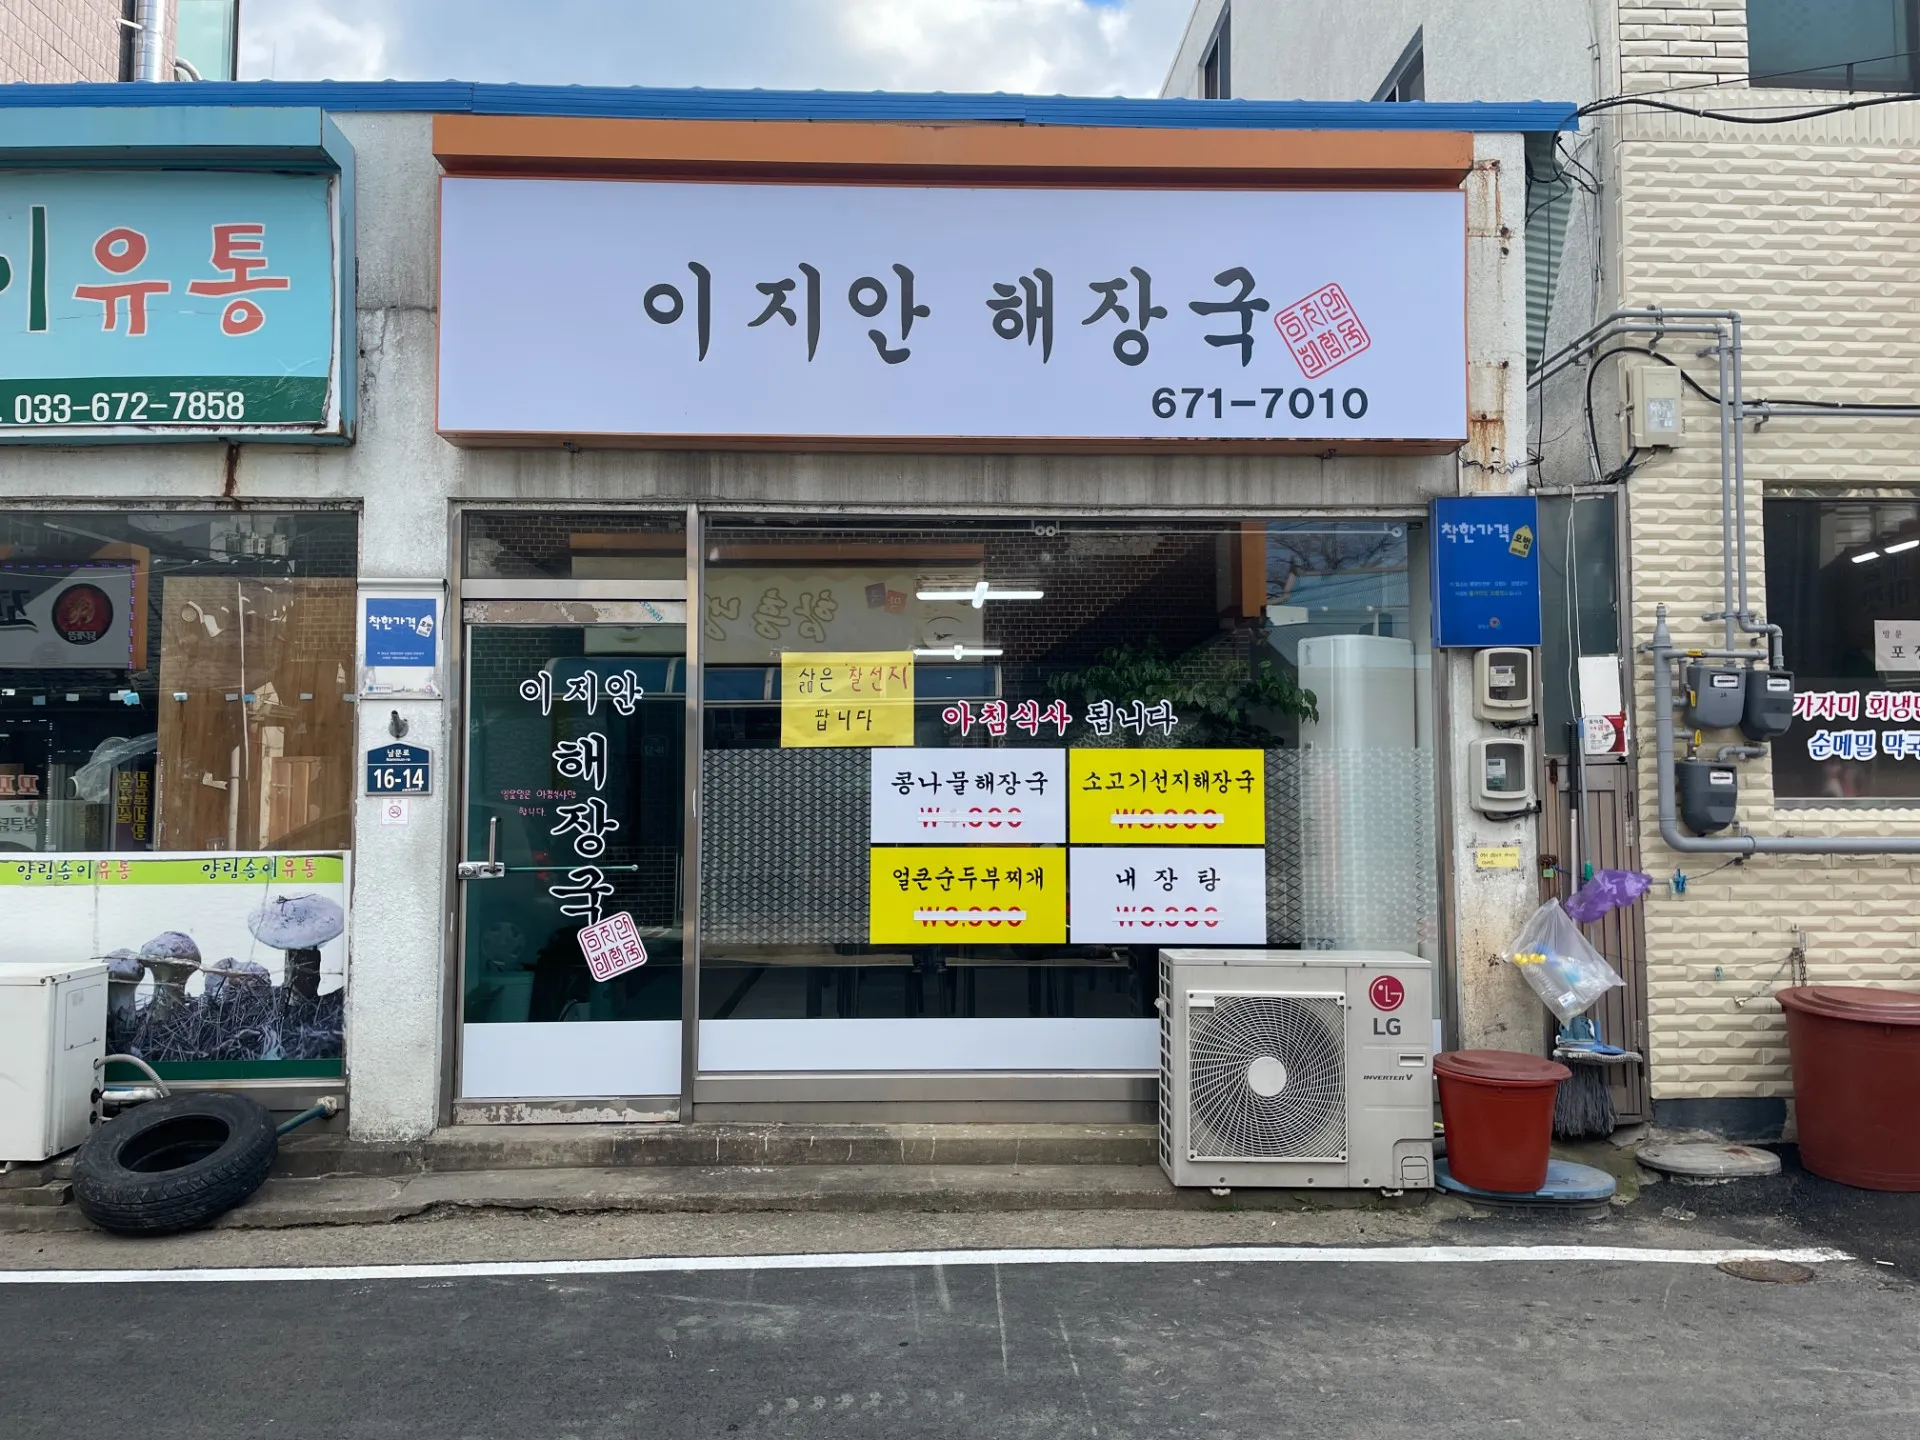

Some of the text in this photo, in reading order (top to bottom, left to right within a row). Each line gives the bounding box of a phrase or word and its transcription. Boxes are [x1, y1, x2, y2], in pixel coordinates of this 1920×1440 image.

[643, 261, 1270, 368] 이지안 해장국
[14, 391, 246, 424] 033-672-7858
[1151, 386, 1369, 420] 671-7010
[1441, 521, 1510, 544] 착한가격
[1513, 533, 1532, 550] 모범
[368, 614, 416, 631] 착한가격
[519, 669, 643, 716] 이지안
[799, 667, 833, 693] 삶은
[942, 699, 1179, 736] 아침식사 됩니다
[1793, 691, 1860, 721] 가자미
[815, 708, 872, 731] 팝니다
[1808, 730, 1877, 761] 순메밀
[373, 767, 425, 789] 16-14
[891, 770, 1049, 796] 콩나물해장국
[1081, 769, 1255, 795] 소고기선지해장국
[549, 731, 620, 928] 해장국
[892, 866, 1045, 892] 얼큰순두부찌개
[1116, 867, 1221, 892] 내장탕
[1373, 1018, 1401, 1035] LG
